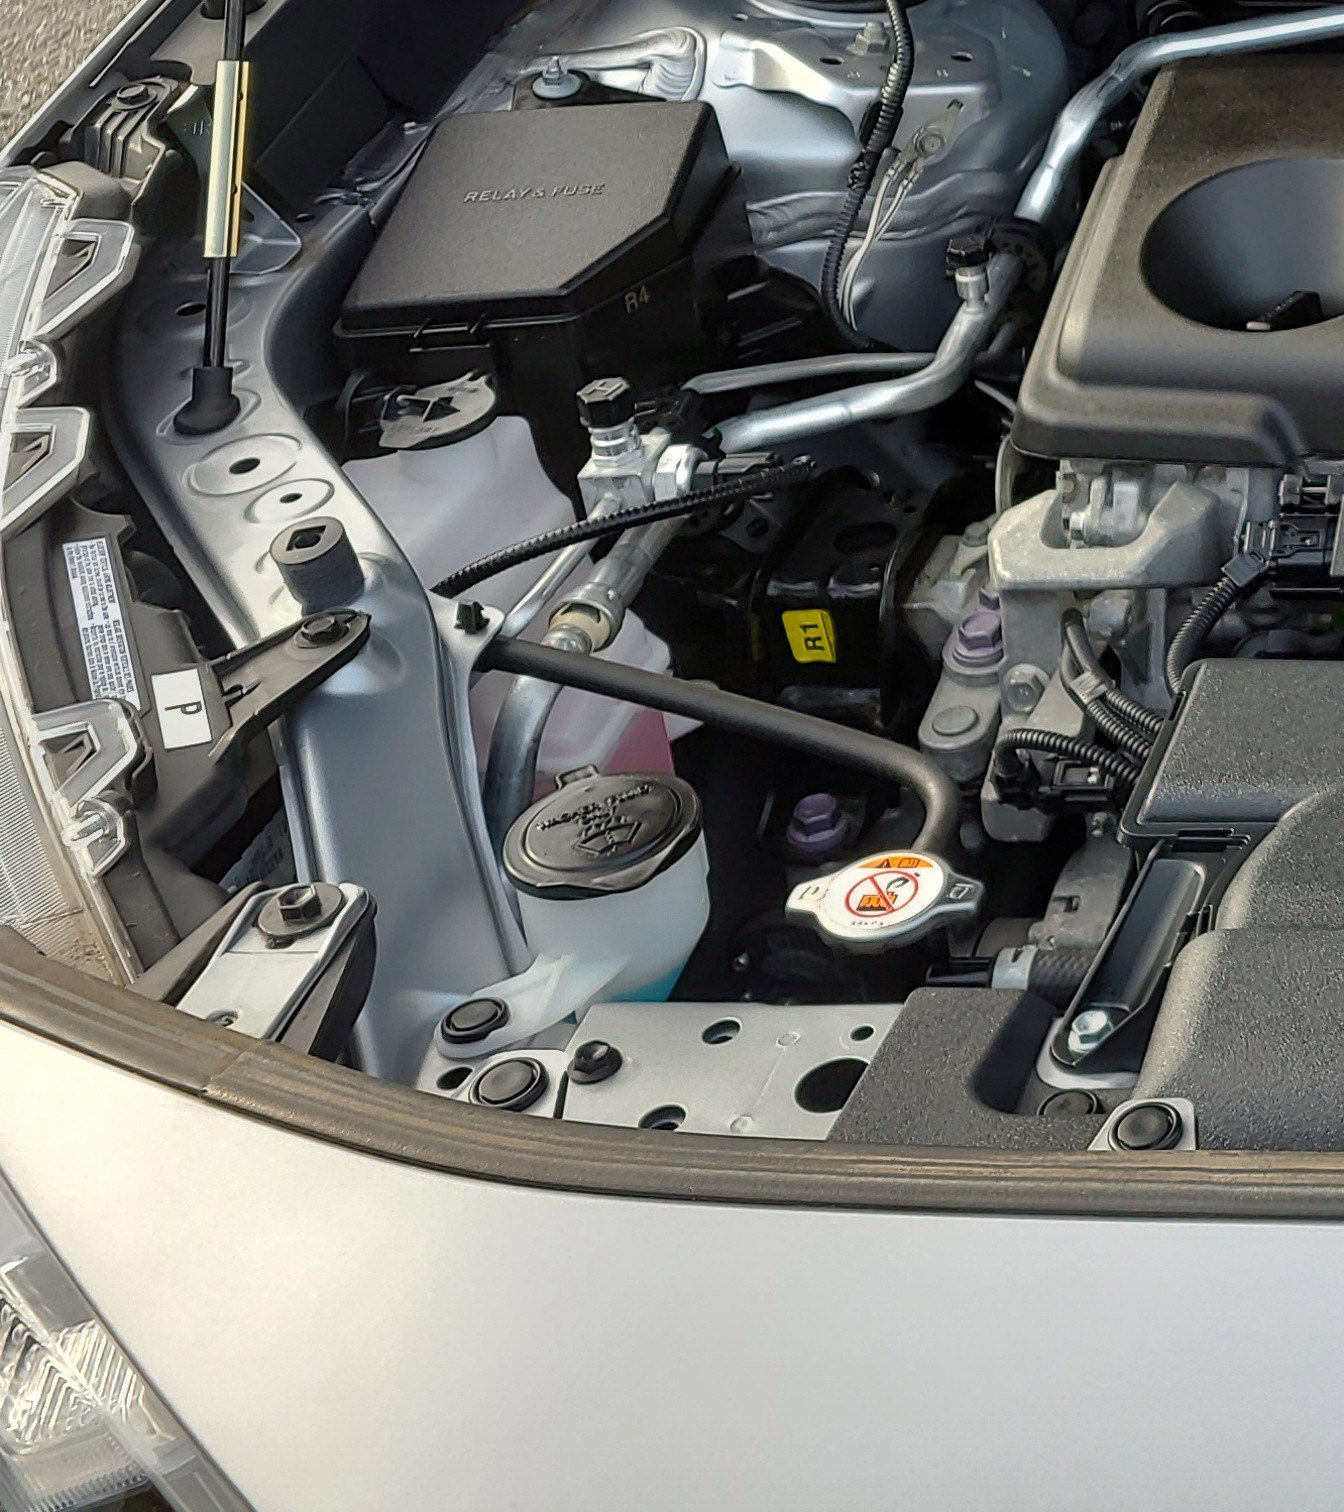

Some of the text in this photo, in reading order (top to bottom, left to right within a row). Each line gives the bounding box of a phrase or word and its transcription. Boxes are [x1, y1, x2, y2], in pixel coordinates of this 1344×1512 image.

[463, 182, 606, 204] RELAY & FUSE
[624, 285, 652, 314] R4
[799, 624, 826, 651] R1
[164, 700, 203, 716] P
